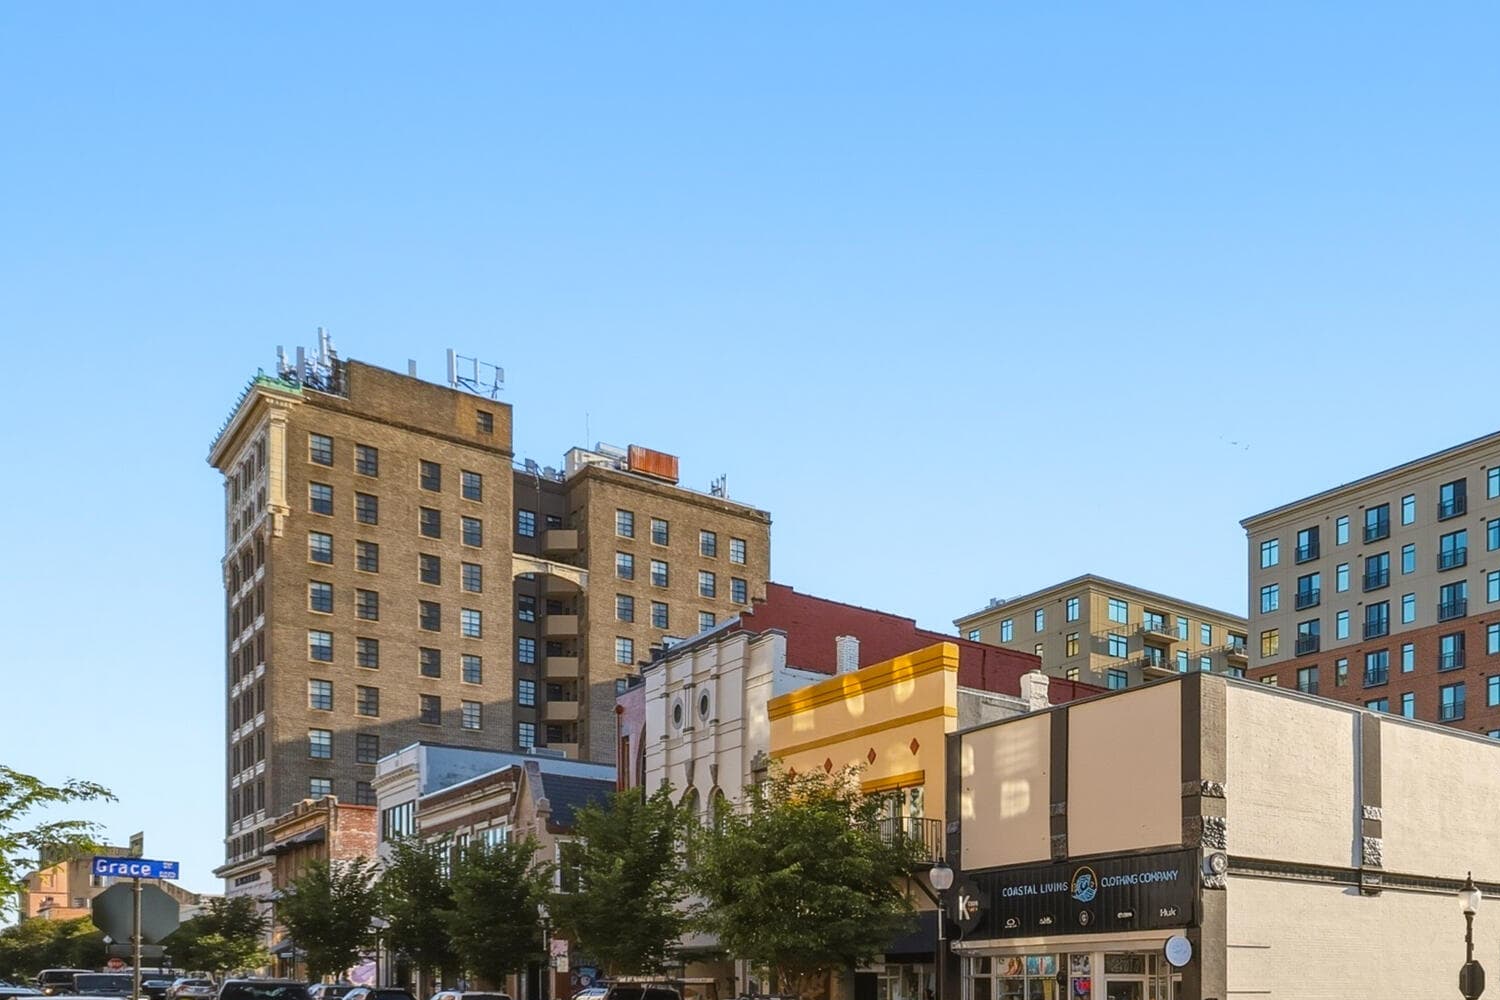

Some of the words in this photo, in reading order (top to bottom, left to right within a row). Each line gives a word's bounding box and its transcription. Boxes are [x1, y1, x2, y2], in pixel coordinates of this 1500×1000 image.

[96, 859, 152, 876] Grace
[1002, 884, 1038, 897] COASTAL
[1040, 881, 1069, 894] LIVING
[1101, 874, 1138, 888] CLOTHING
[1139, 870, 1178, 883] COMPANY
[959, 895, 971, 921] K
